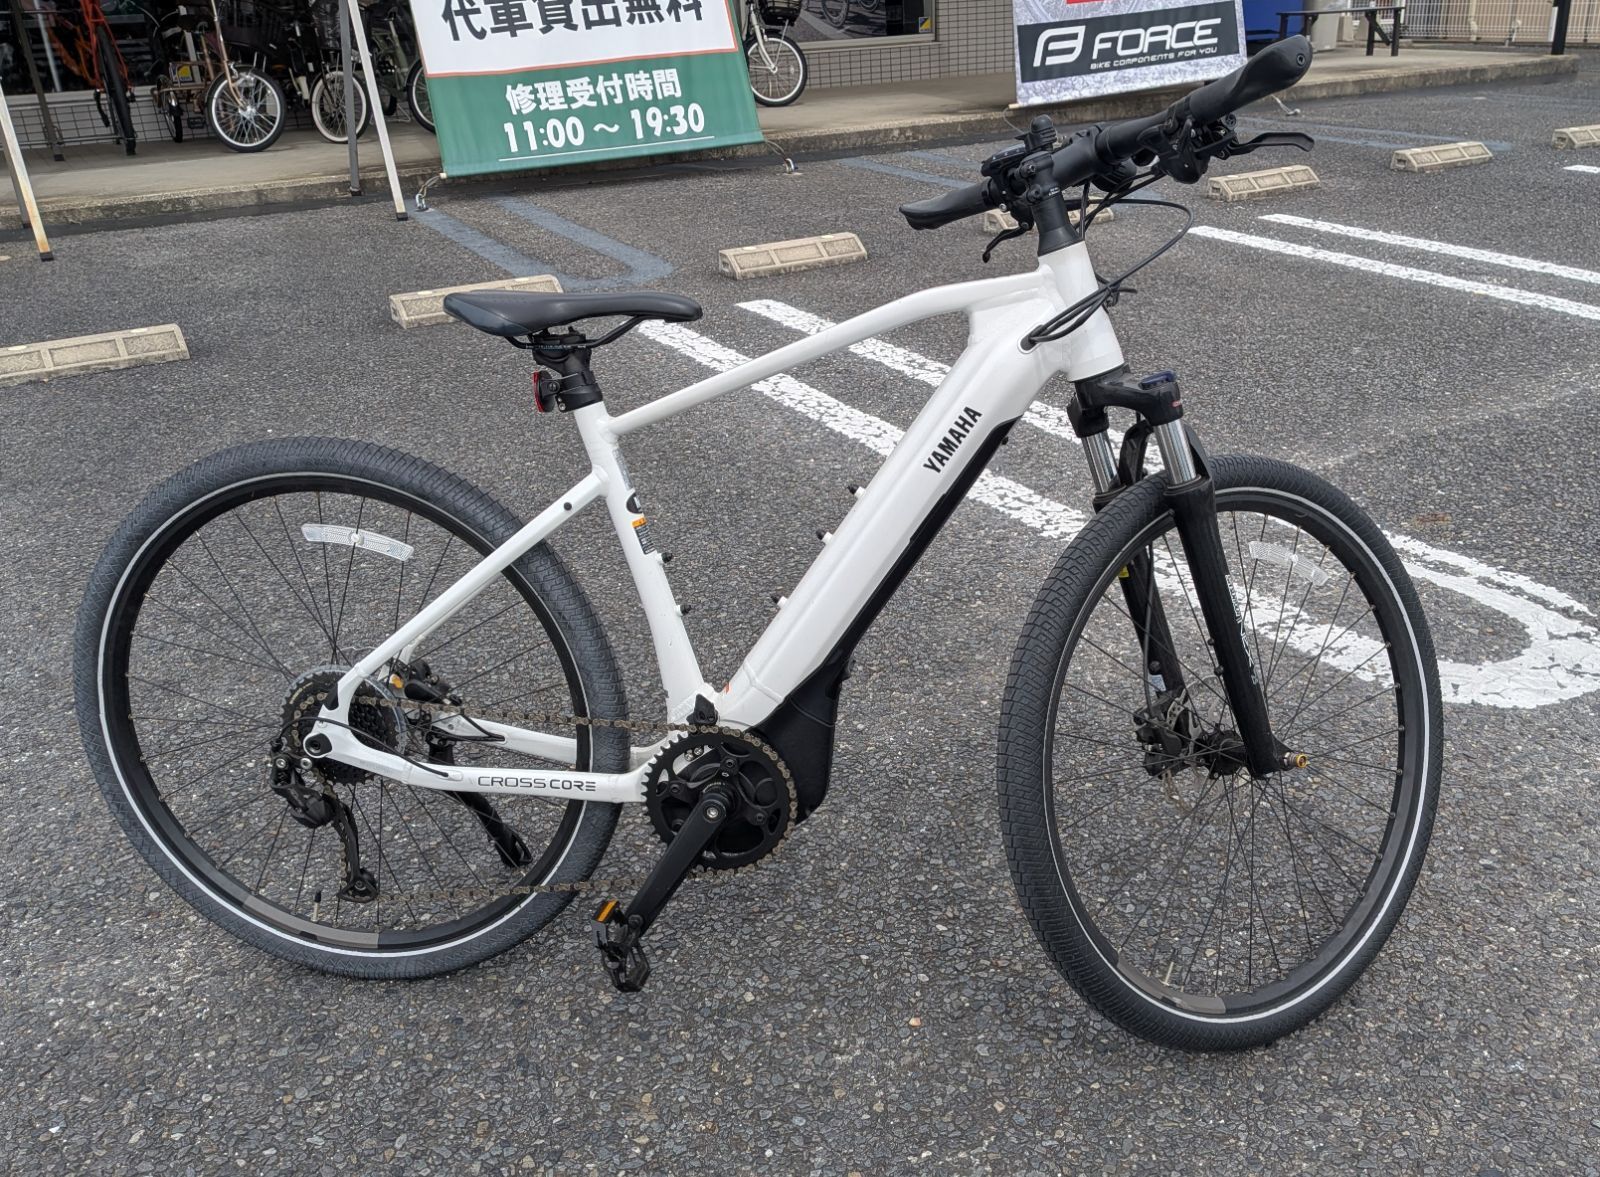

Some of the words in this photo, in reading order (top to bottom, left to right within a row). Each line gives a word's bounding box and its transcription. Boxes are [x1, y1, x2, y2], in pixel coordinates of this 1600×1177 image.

[1090, 61, 1111, 70] BIKE
[1113, 52, 1175, 67] COMPONENTS
[1177, 49, 1197, 58] FOR
[1199, 46, 1218, 55] YOU
[1092, 18, 1221, 60] FORCE
[505, 69, 682, 116] 修理受付時間
[504, 117, 584, 153] 11:00
[631, 102, 705, 140] 19:30
[923, 406, 983, 473] YAMAHA
[477, 776, 546, 789] CROSS
[549, 779, 597, 792] CORE
